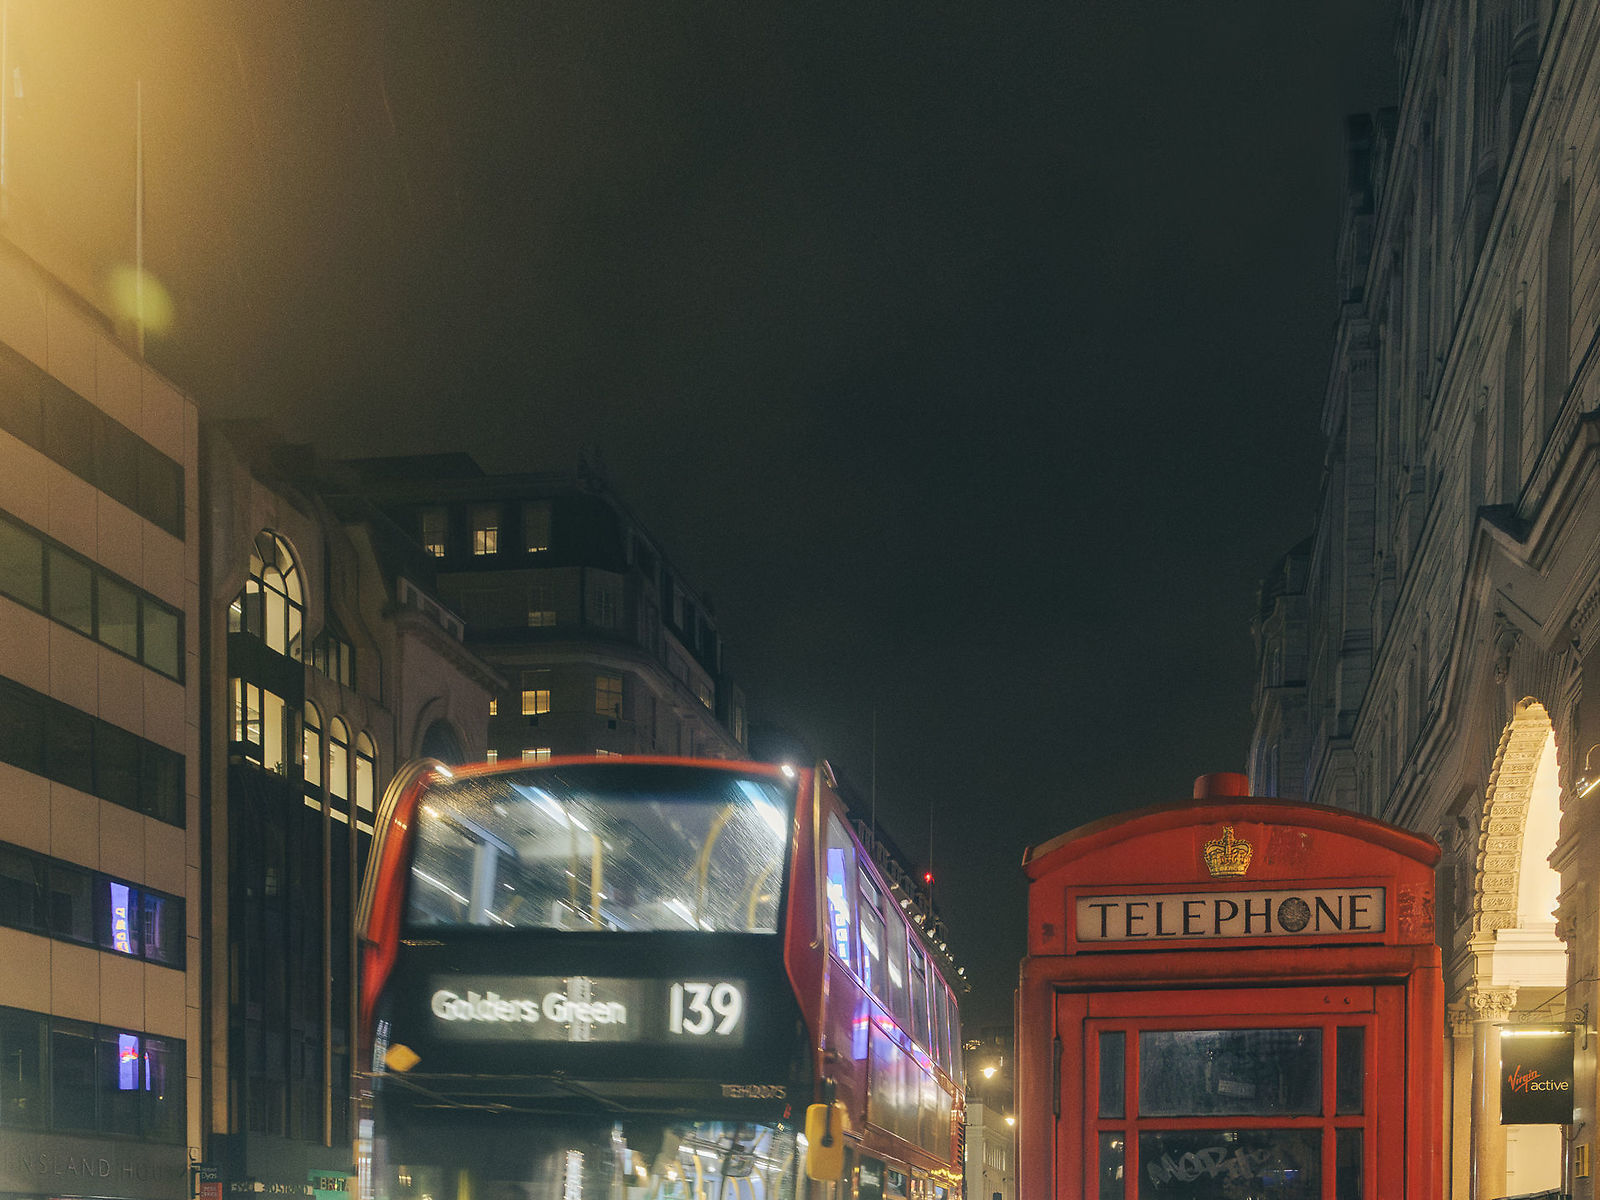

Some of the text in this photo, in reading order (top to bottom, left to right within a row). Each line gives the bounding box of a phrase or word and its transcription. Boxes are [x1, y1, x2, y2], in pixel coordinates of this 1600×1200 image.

[1088, 894, 1373, 938] TELEPHONE
[430, 989, 628, 1025] Golders Green
[669, 982, 743, 1036] 139
[1508, 1064, 1542, 1093] Virgin
[1530, 1079, 1569, 1091] active
